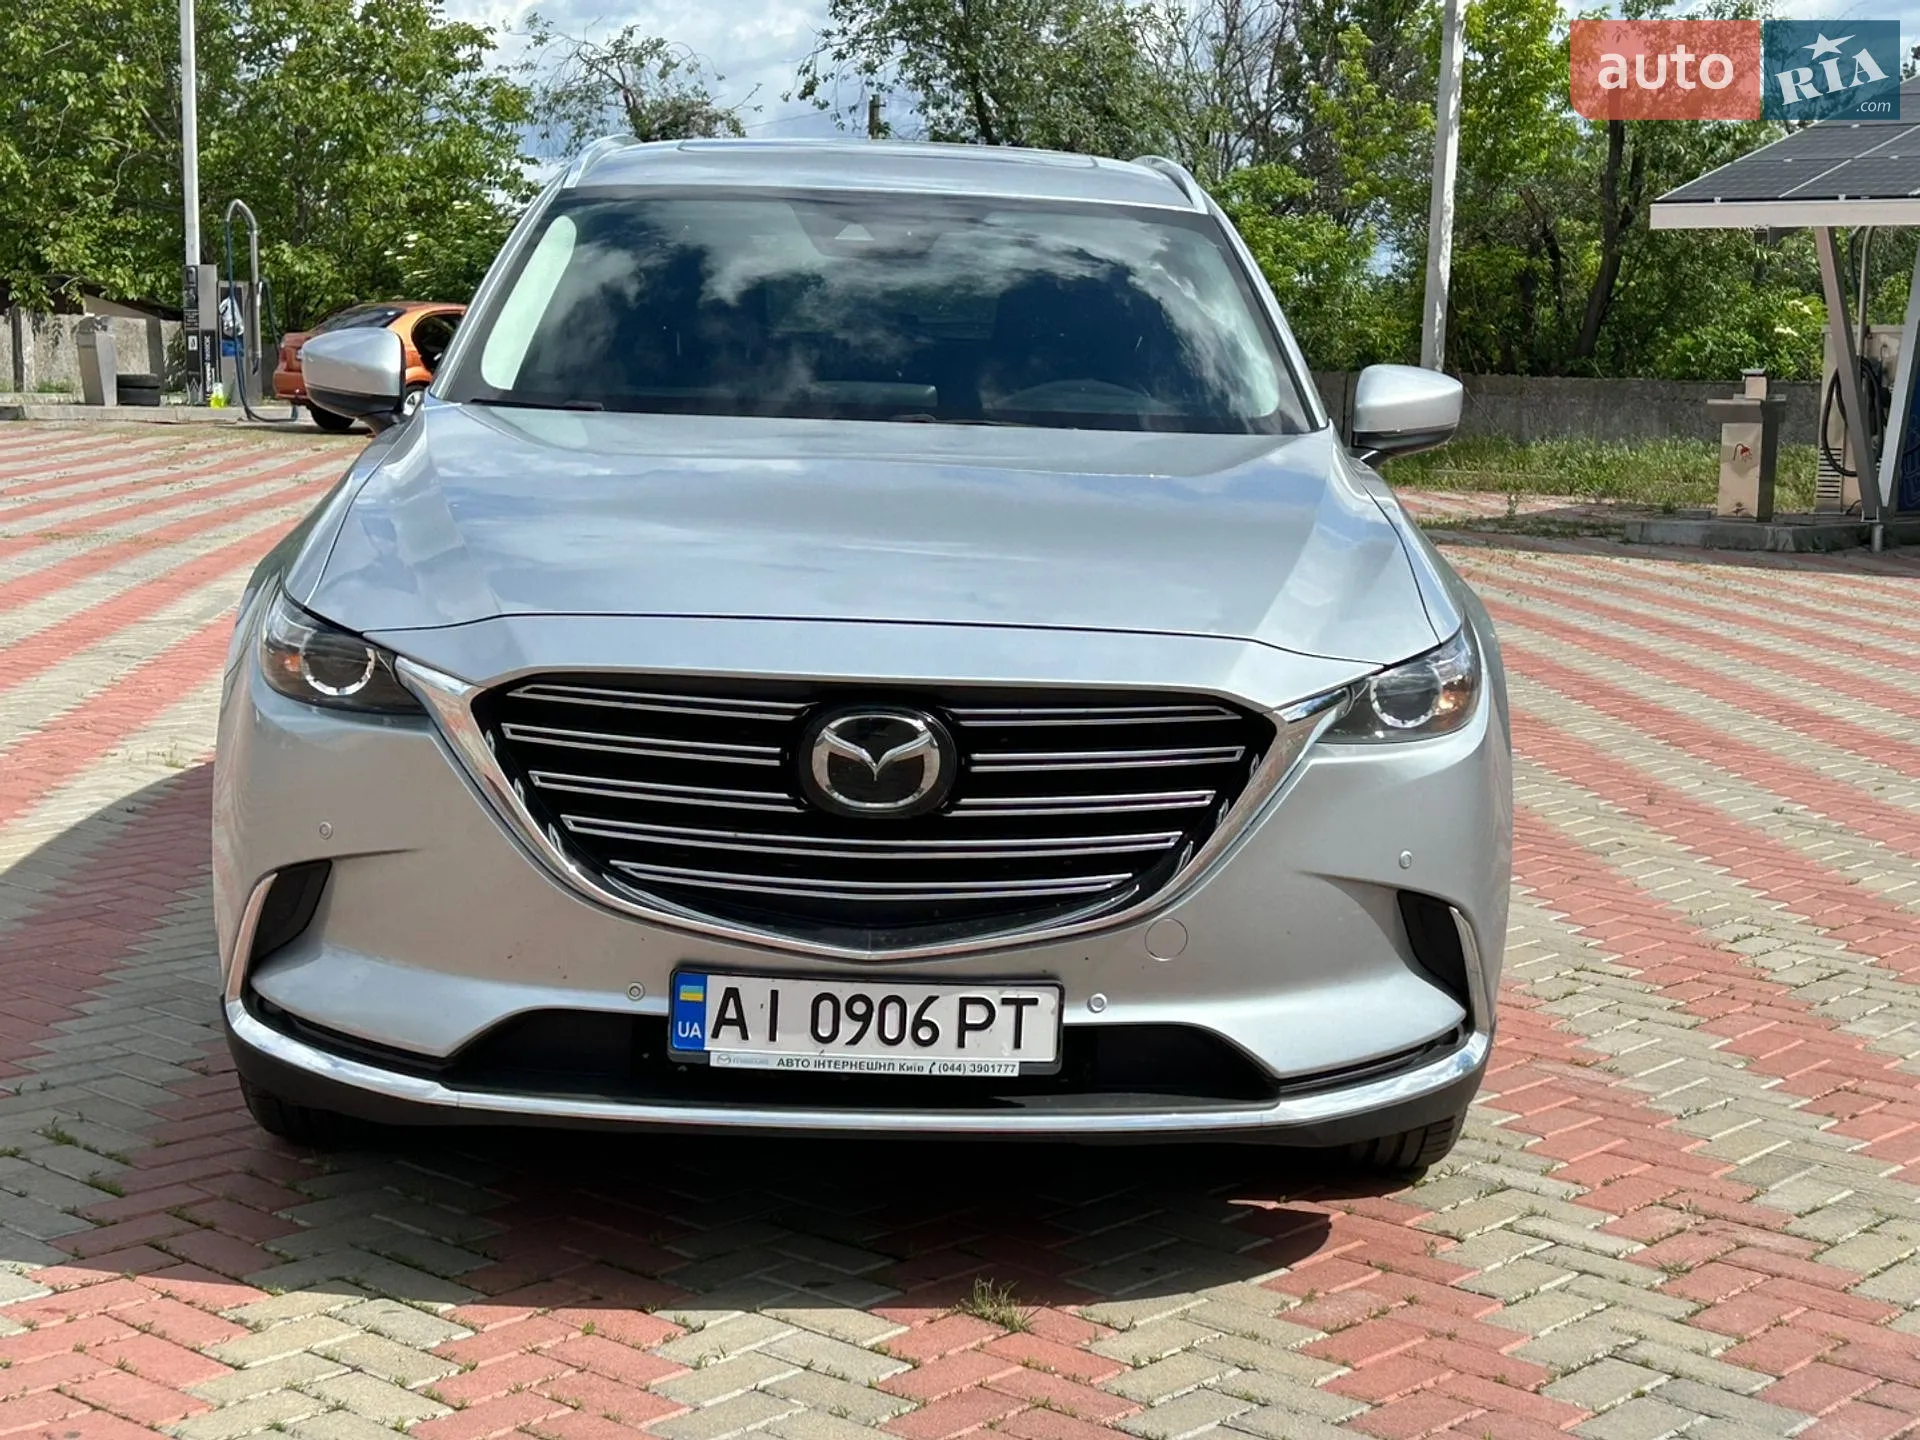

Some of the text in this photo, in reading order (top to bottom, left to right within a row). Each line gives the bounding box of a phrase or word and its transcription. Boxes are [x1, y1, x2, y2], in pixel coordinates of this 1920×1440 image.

[677, 1020, 702, 1039] UA
[810, 992, 941, 1048] 0906
[777, 1057, 811, 1069] АВТО
[938, 1062, 968, 1075] (044)
[969, 1062, 1017, 1075] 3901777
